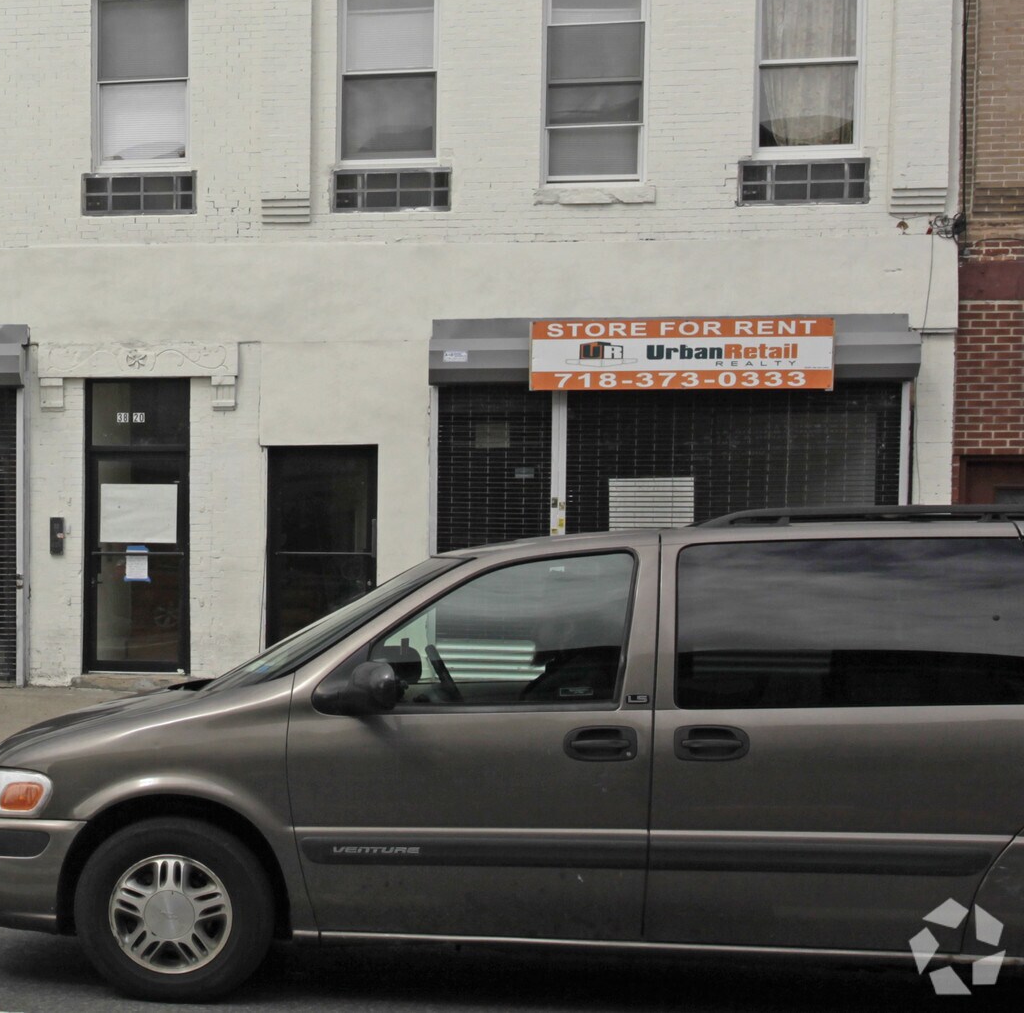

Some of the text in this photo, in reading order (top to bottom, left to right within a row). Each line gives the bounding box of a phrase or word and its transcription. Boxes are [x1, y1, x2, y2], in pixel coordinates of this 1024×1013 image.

[546, 319, 818, 338] STORE FOR RENT
[553, 371, 807, 388] 718-373-0333
[332, 846, 421, 854] VENTURE
